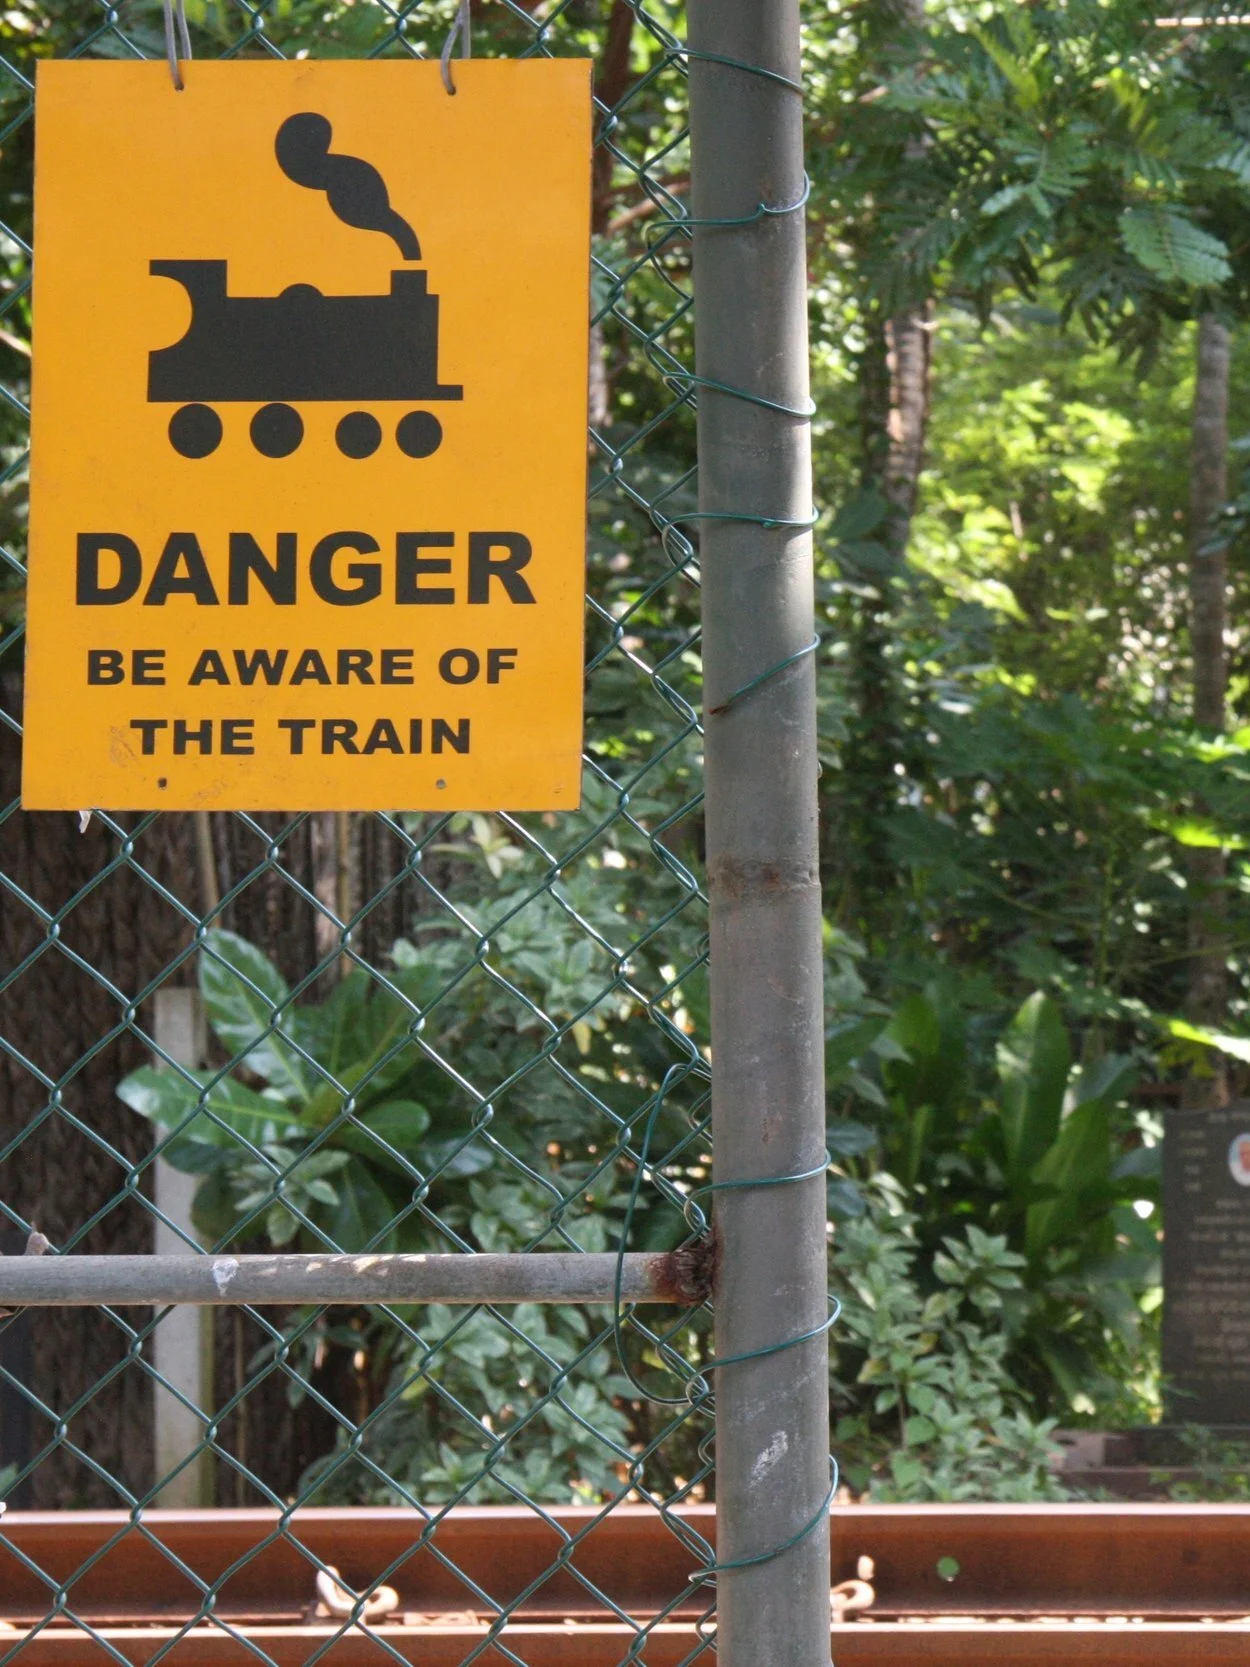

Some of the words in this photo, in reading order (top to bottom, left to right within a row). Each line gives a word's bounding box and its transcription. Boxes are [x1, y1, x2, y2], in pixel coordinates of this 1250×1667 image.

[77, 532, 536, 606] DANGER
[88, 650, 166, 686] BE
[189, 650, 414, 686] AWARE
[439, 649, 517, 685] OF
[131, 719, 254, 755] THE
[279, 719, 470, 755] TRAIN
